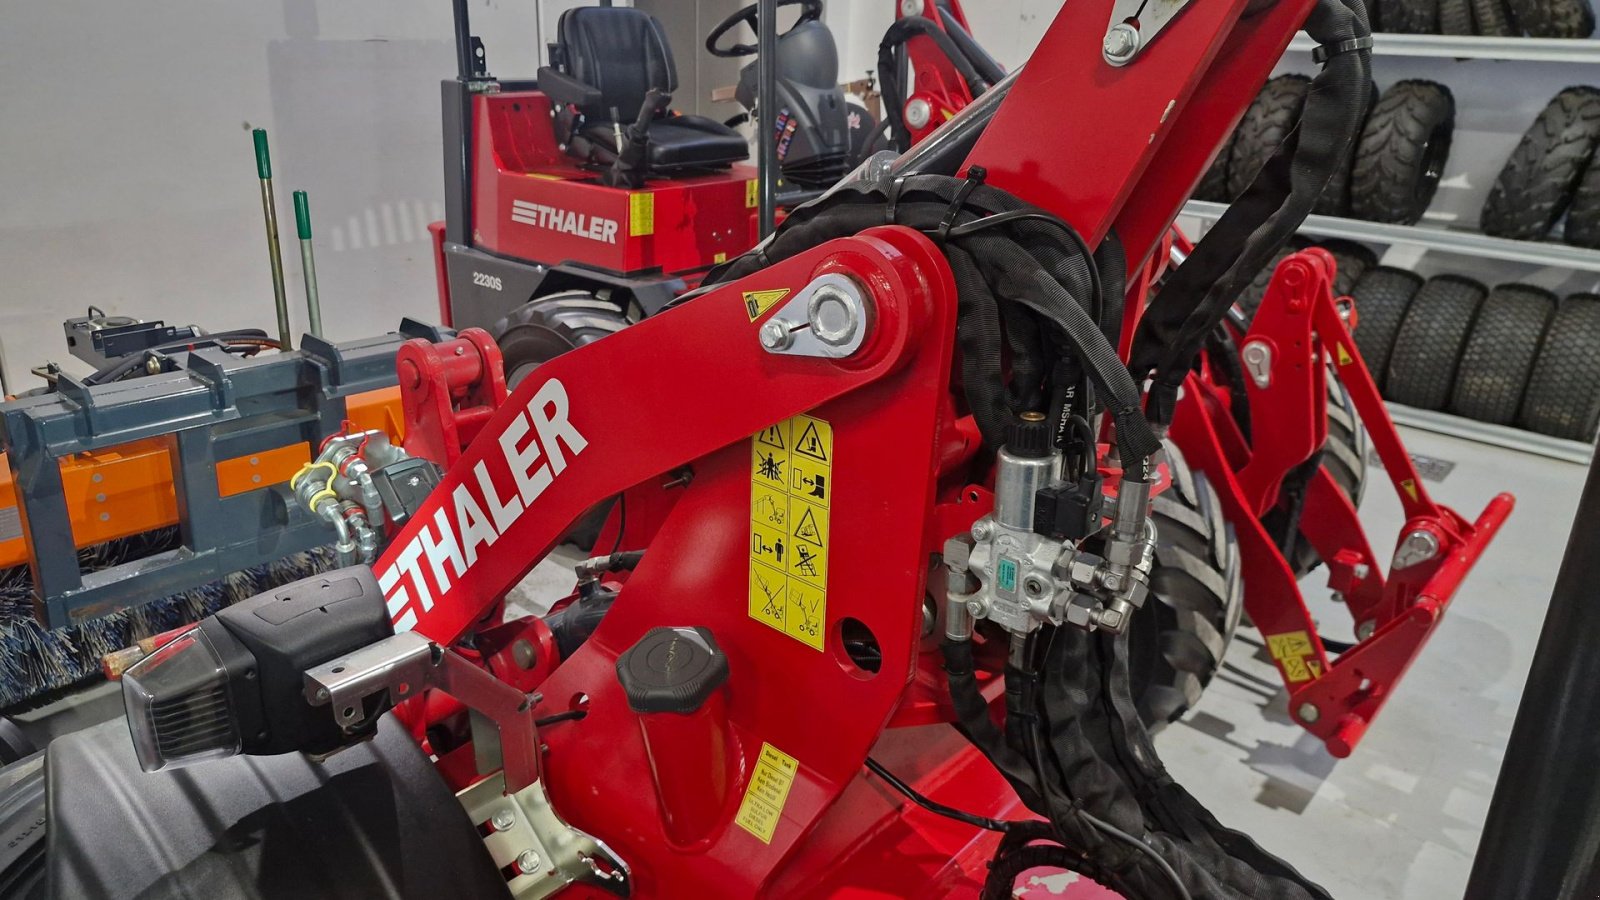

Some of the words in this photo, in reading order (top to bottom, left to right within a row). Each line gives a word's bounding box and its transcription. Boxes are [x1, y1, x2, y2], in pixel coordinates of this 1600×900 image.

[536, 204, 619, 244] THALER
[473, 271, 503, 291] 2230S
[396, 378, 588, 613] THALER
[765, 750, 778, 761] Diesel
[781, 759, 791, 769] Tank
